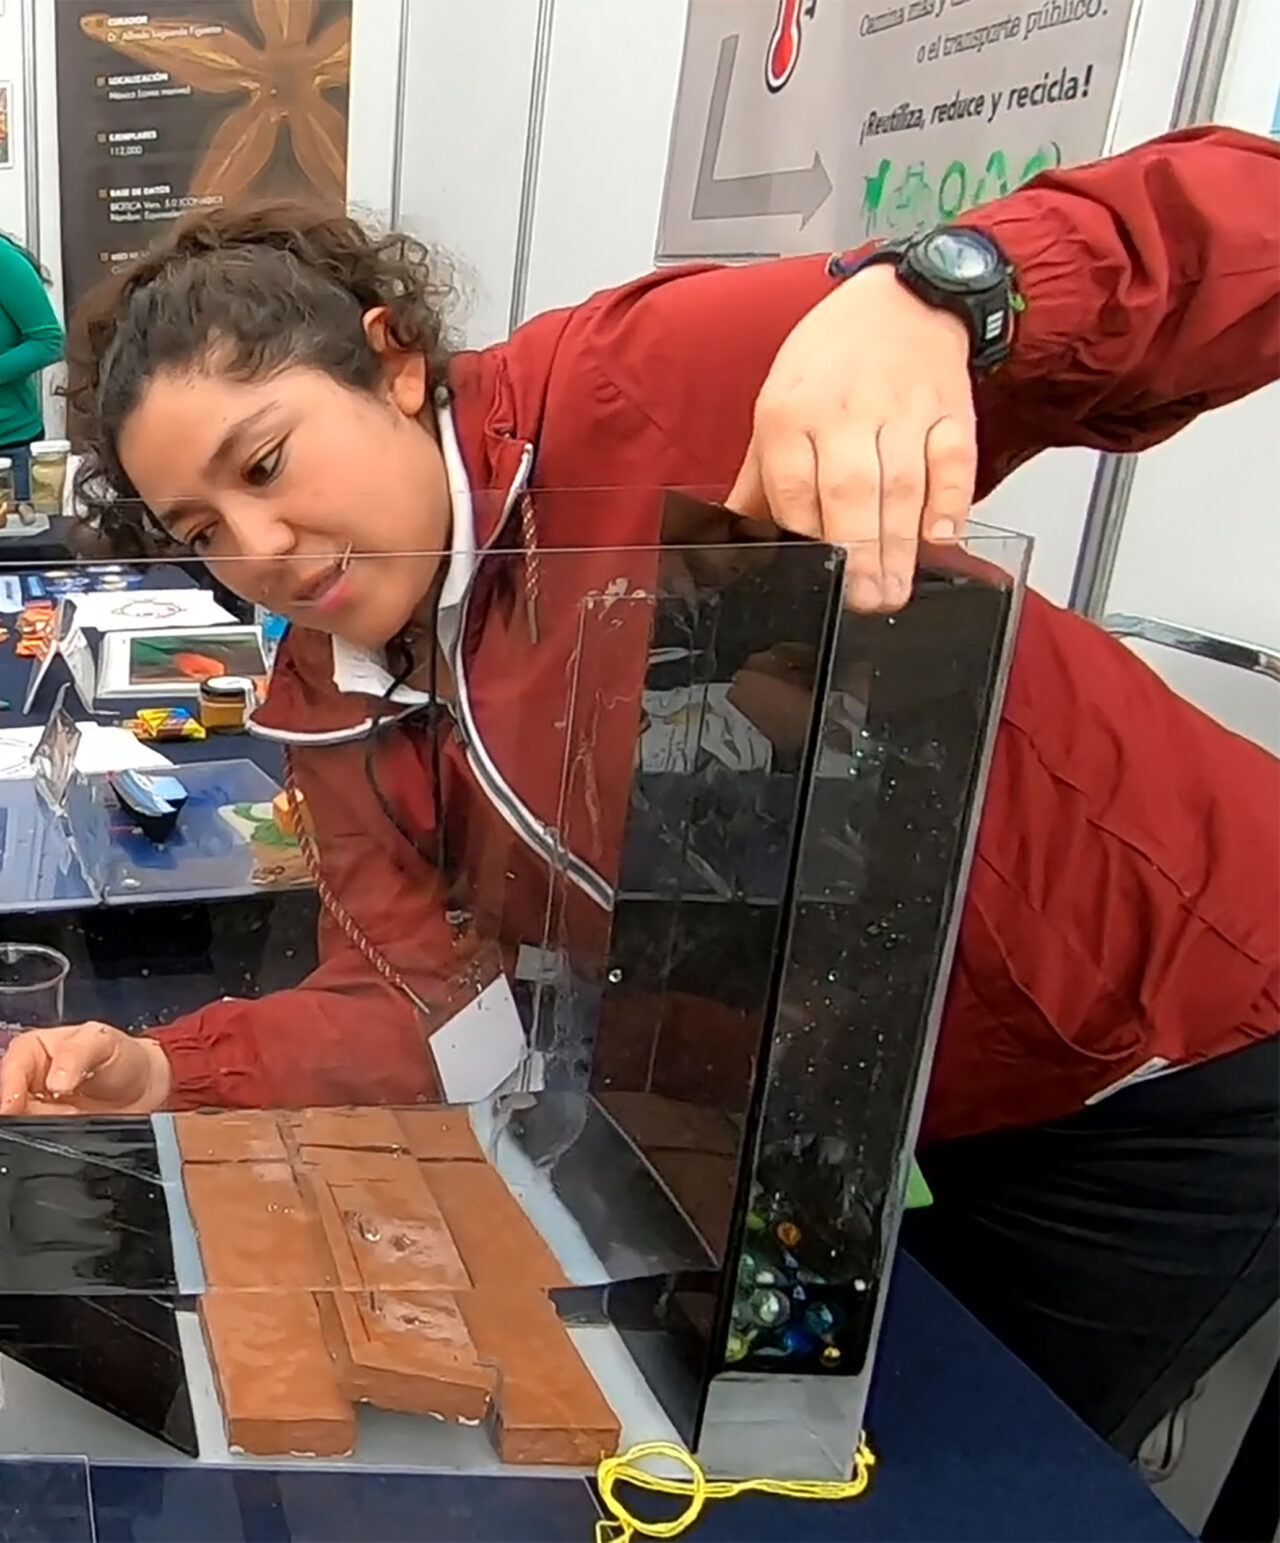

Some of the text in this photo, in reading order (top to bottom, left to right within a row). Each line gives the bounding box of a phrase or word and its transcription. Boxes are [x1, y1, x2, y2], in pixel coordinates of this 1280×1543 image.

[917, 44, 926, 64] o
[942, 15, 1021, 53] transporte
[858, 64, 1095, 147] ¡Reutiliza, reduce y recicla!
